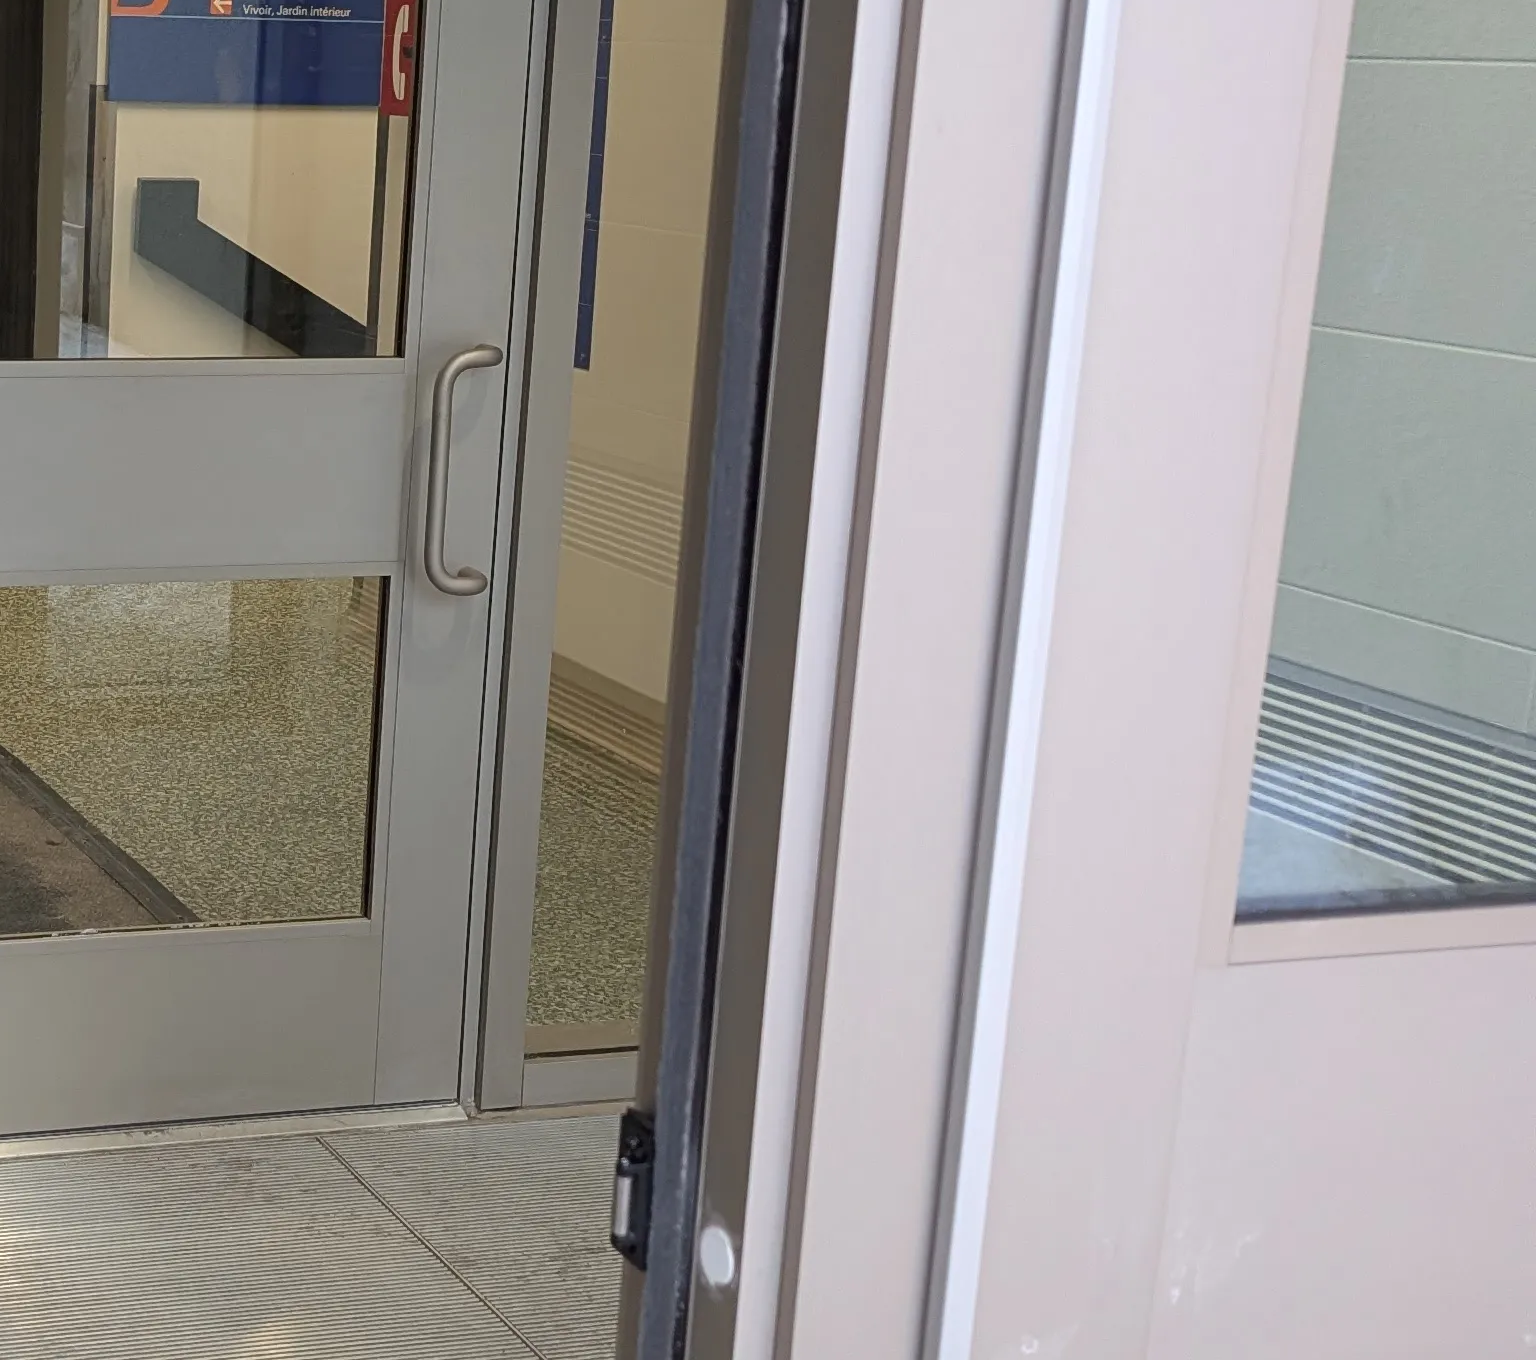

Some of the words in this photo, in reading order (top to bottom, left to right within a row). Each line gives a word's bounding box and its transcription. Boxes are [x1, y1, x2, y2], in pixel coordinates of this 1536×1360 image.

[242, 4, 275, 17] Vivoir,
[276, 5, 308, 16] Jardin
[309, 6, 352, 17] intérieur
